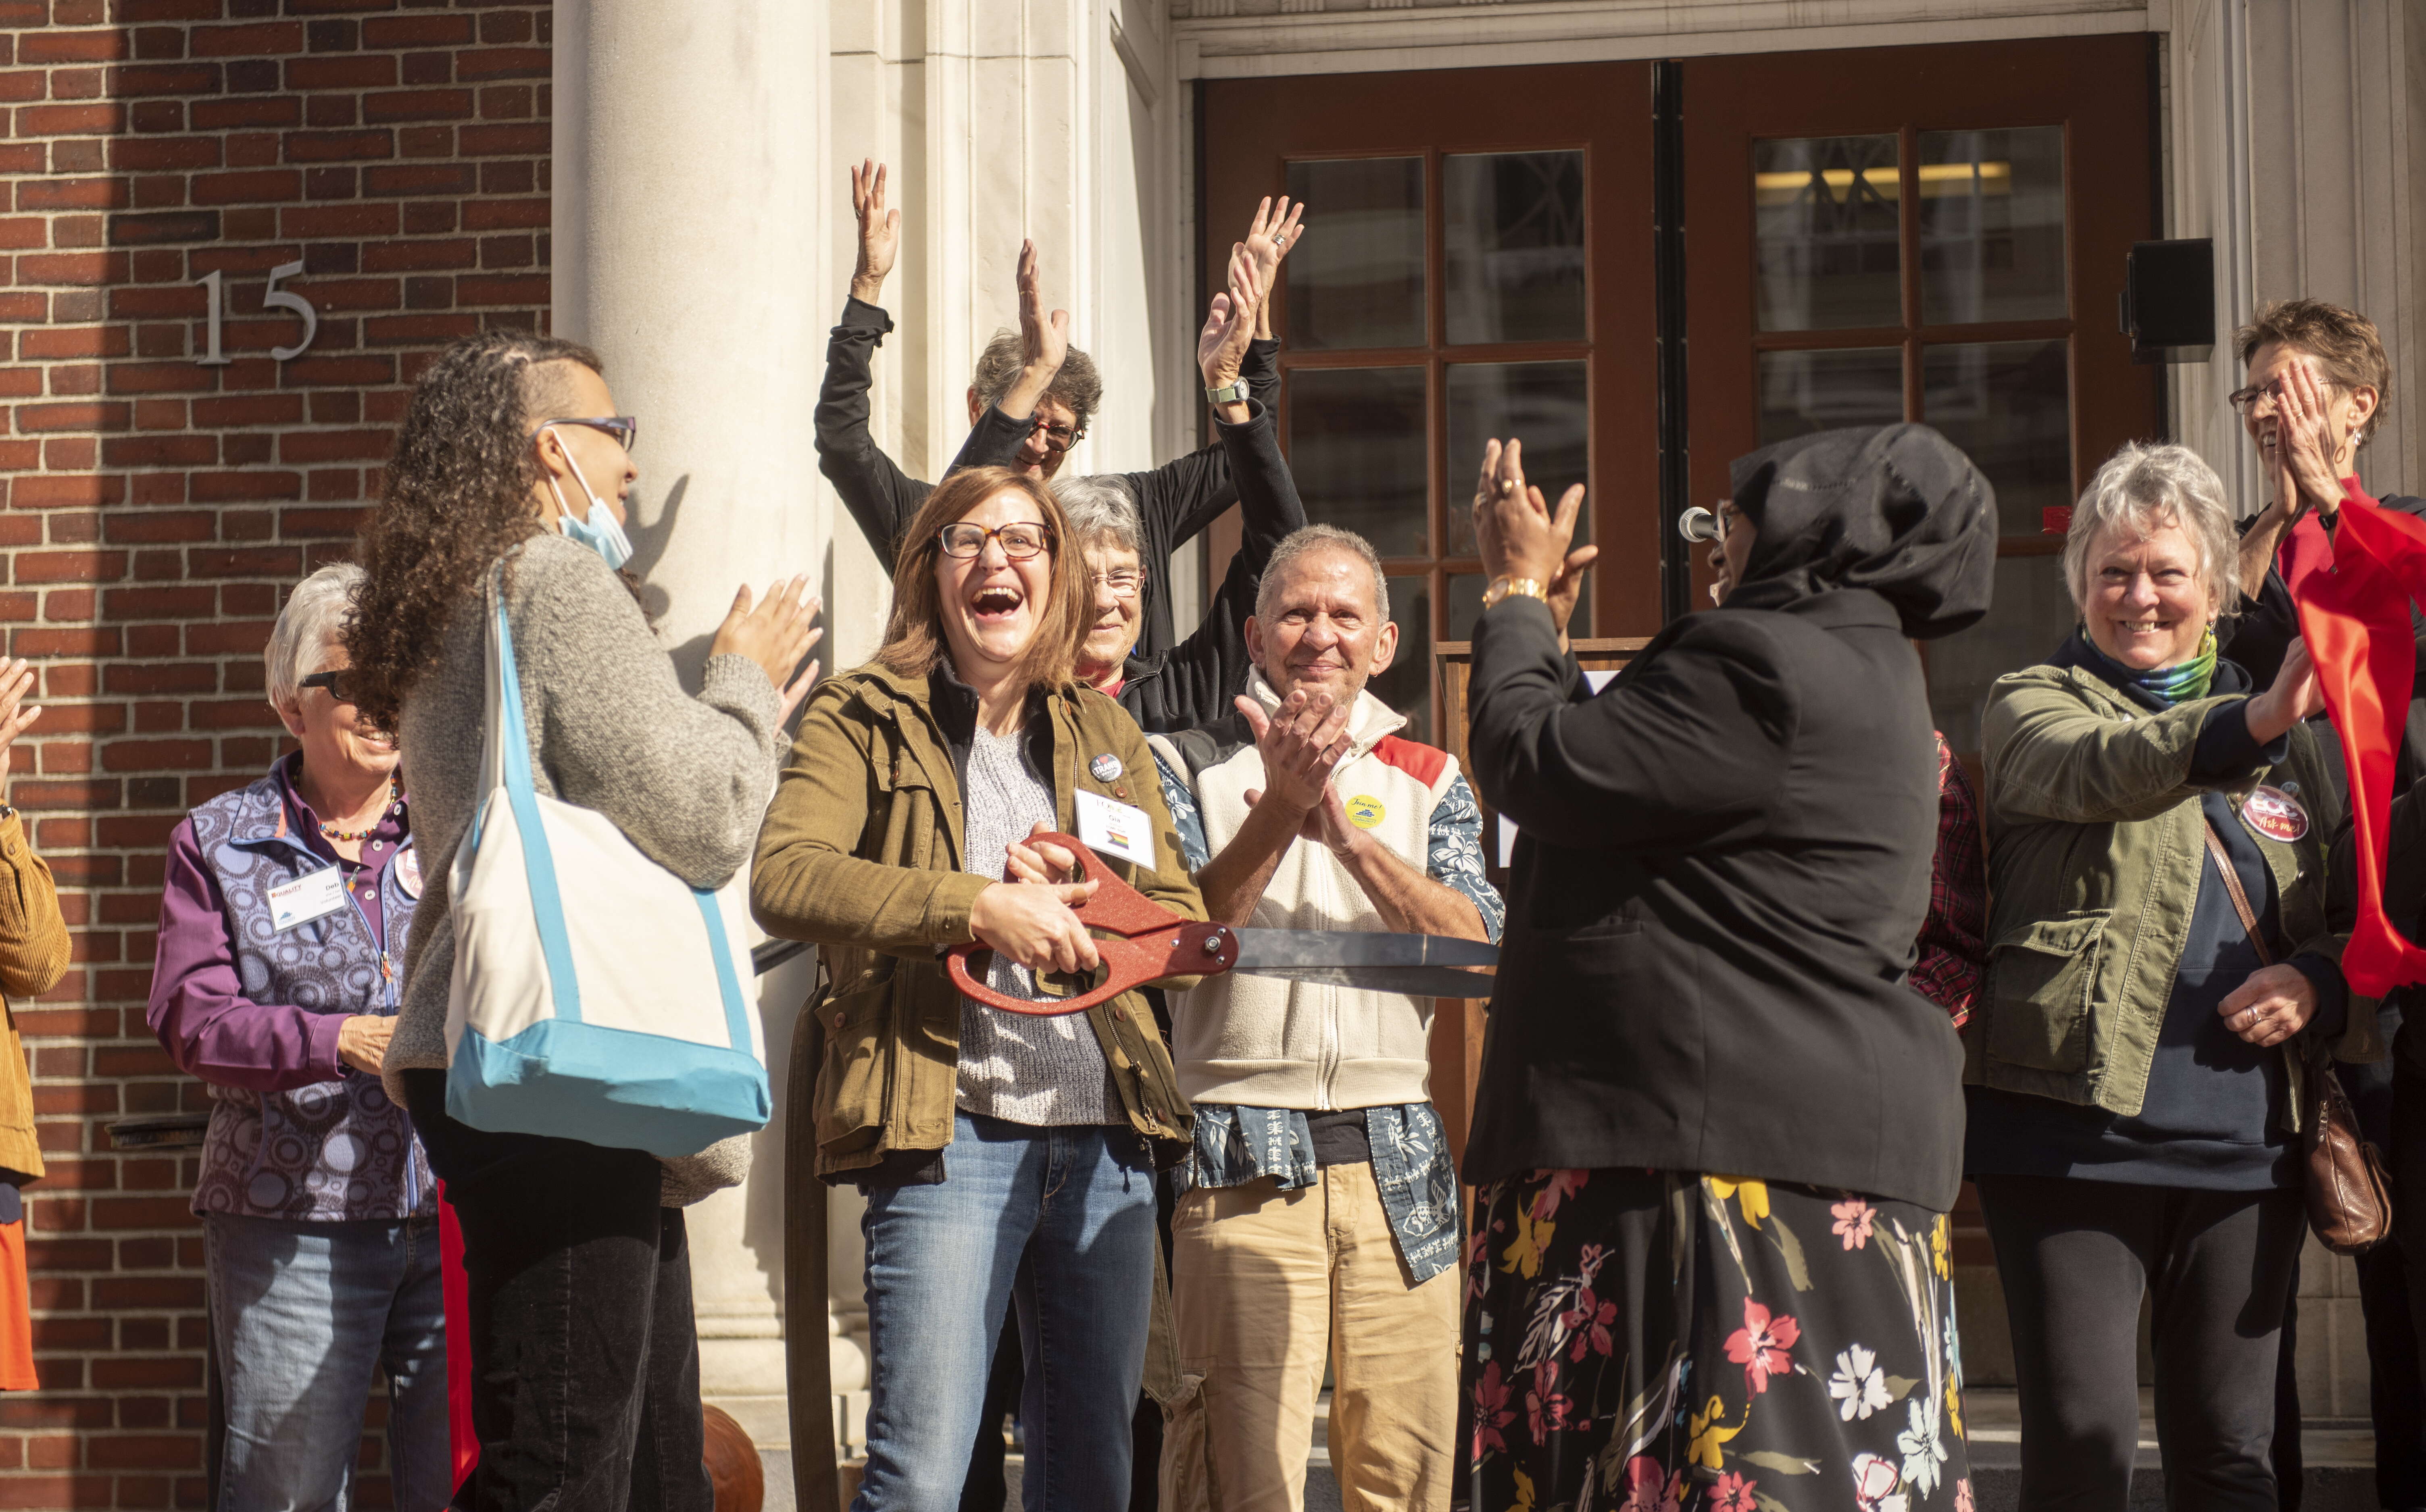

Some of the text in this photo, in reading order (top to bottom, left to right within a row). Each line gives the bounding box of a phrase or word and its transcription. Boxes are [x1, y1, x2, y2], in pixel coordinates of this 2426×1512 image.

[195, 259, 317, 365] 15
[1094, 760, 1118, 774] TRANS
[1351, 798, 1367, 806] Join
[2250, 795, 2298, 817] ECC
[2258, 816, 2300, 833] Ask me!
